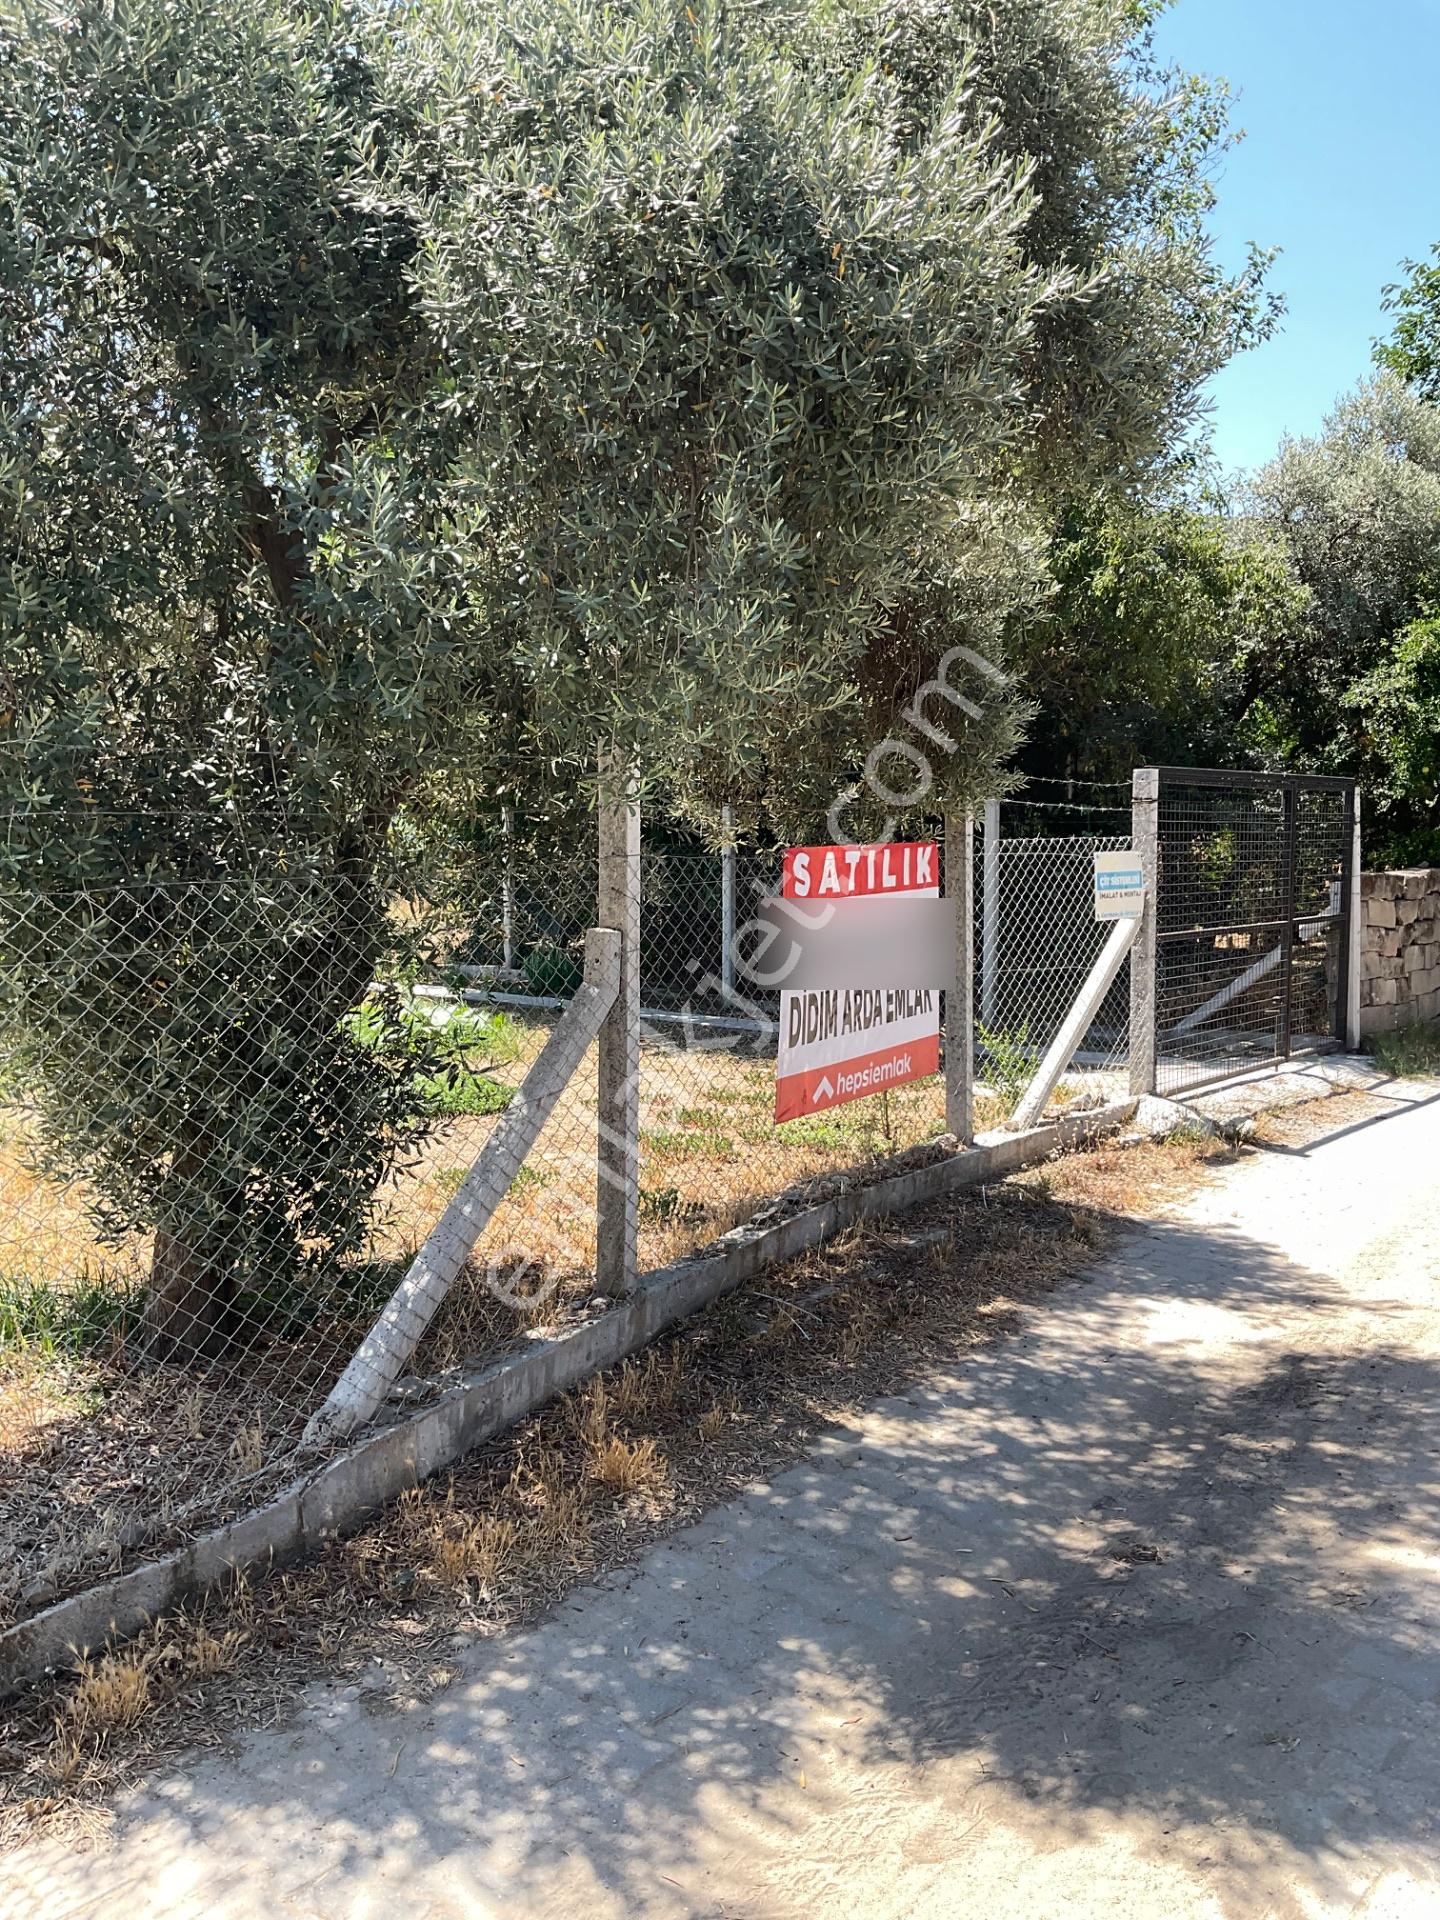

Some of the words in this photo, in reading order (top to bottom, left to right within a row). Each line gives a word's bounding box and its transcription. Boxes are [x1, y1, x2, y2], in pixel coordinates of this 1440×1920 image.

[793, 847, 932, 897] SATILIK
[841, 990, 882, 1036] ARDA
[837, 1053, 911, 1095] hepsiemlak
